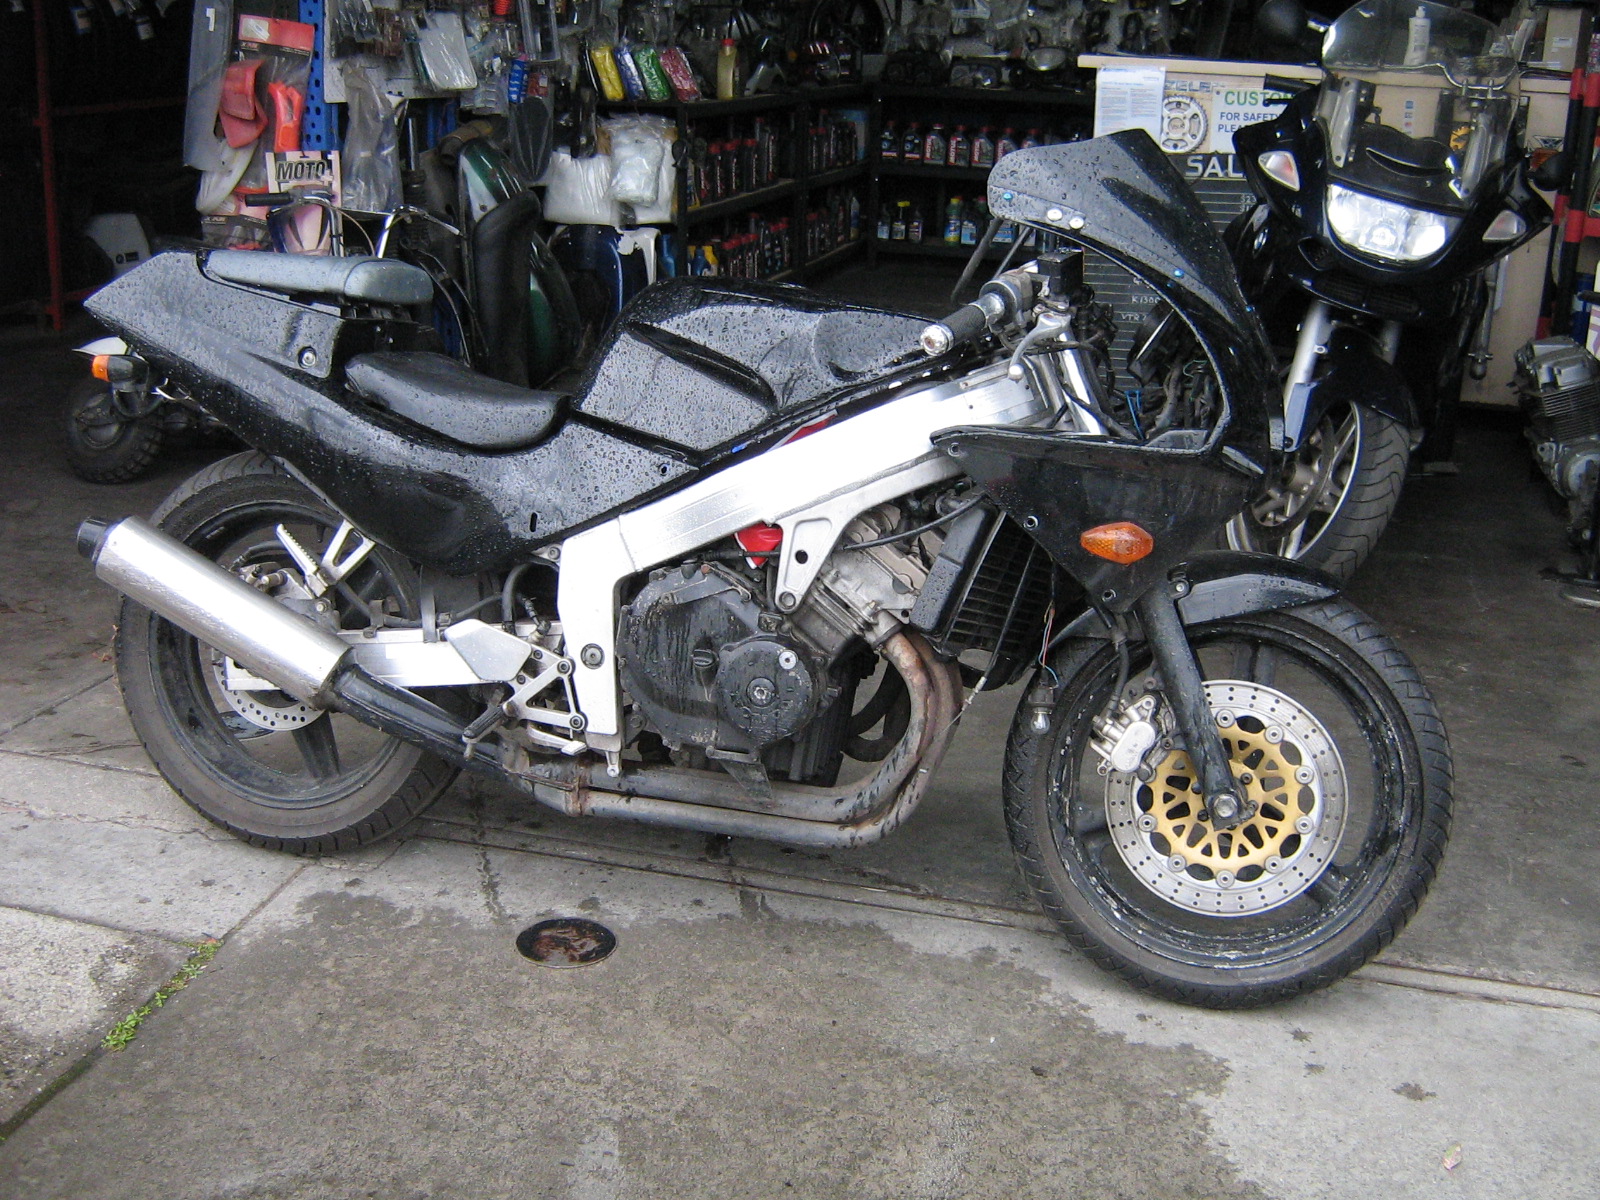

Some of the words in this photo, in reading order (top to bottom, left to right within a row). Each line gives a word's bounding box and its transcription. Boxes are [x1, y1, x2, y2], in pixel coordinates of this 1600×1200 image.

[1220, 112, 1240, 121] FOR
[276, 160, 326, 181] MOTO
[1185, 155, 1246, 178] SAL
